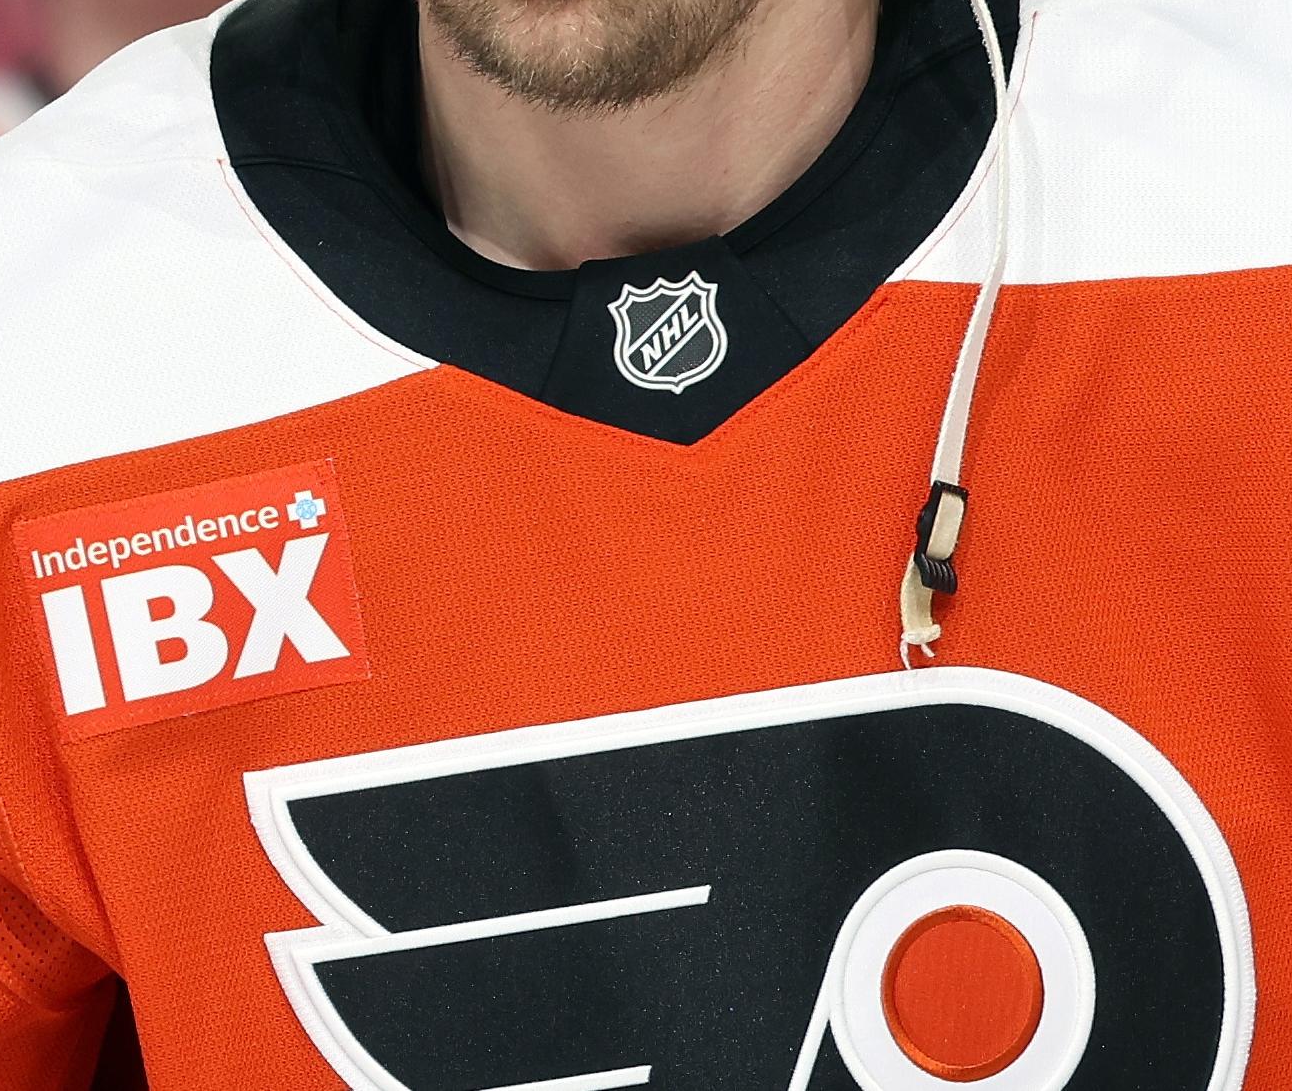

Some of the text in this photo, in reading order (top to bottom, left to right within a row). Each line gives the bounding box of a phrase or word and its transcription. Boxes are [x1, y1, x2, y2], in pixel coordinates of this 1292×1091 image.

[639, 304, 699, 371] NHL
[32, 507, 279, 579] Independence
[41, 533, 351, 716] IBX
